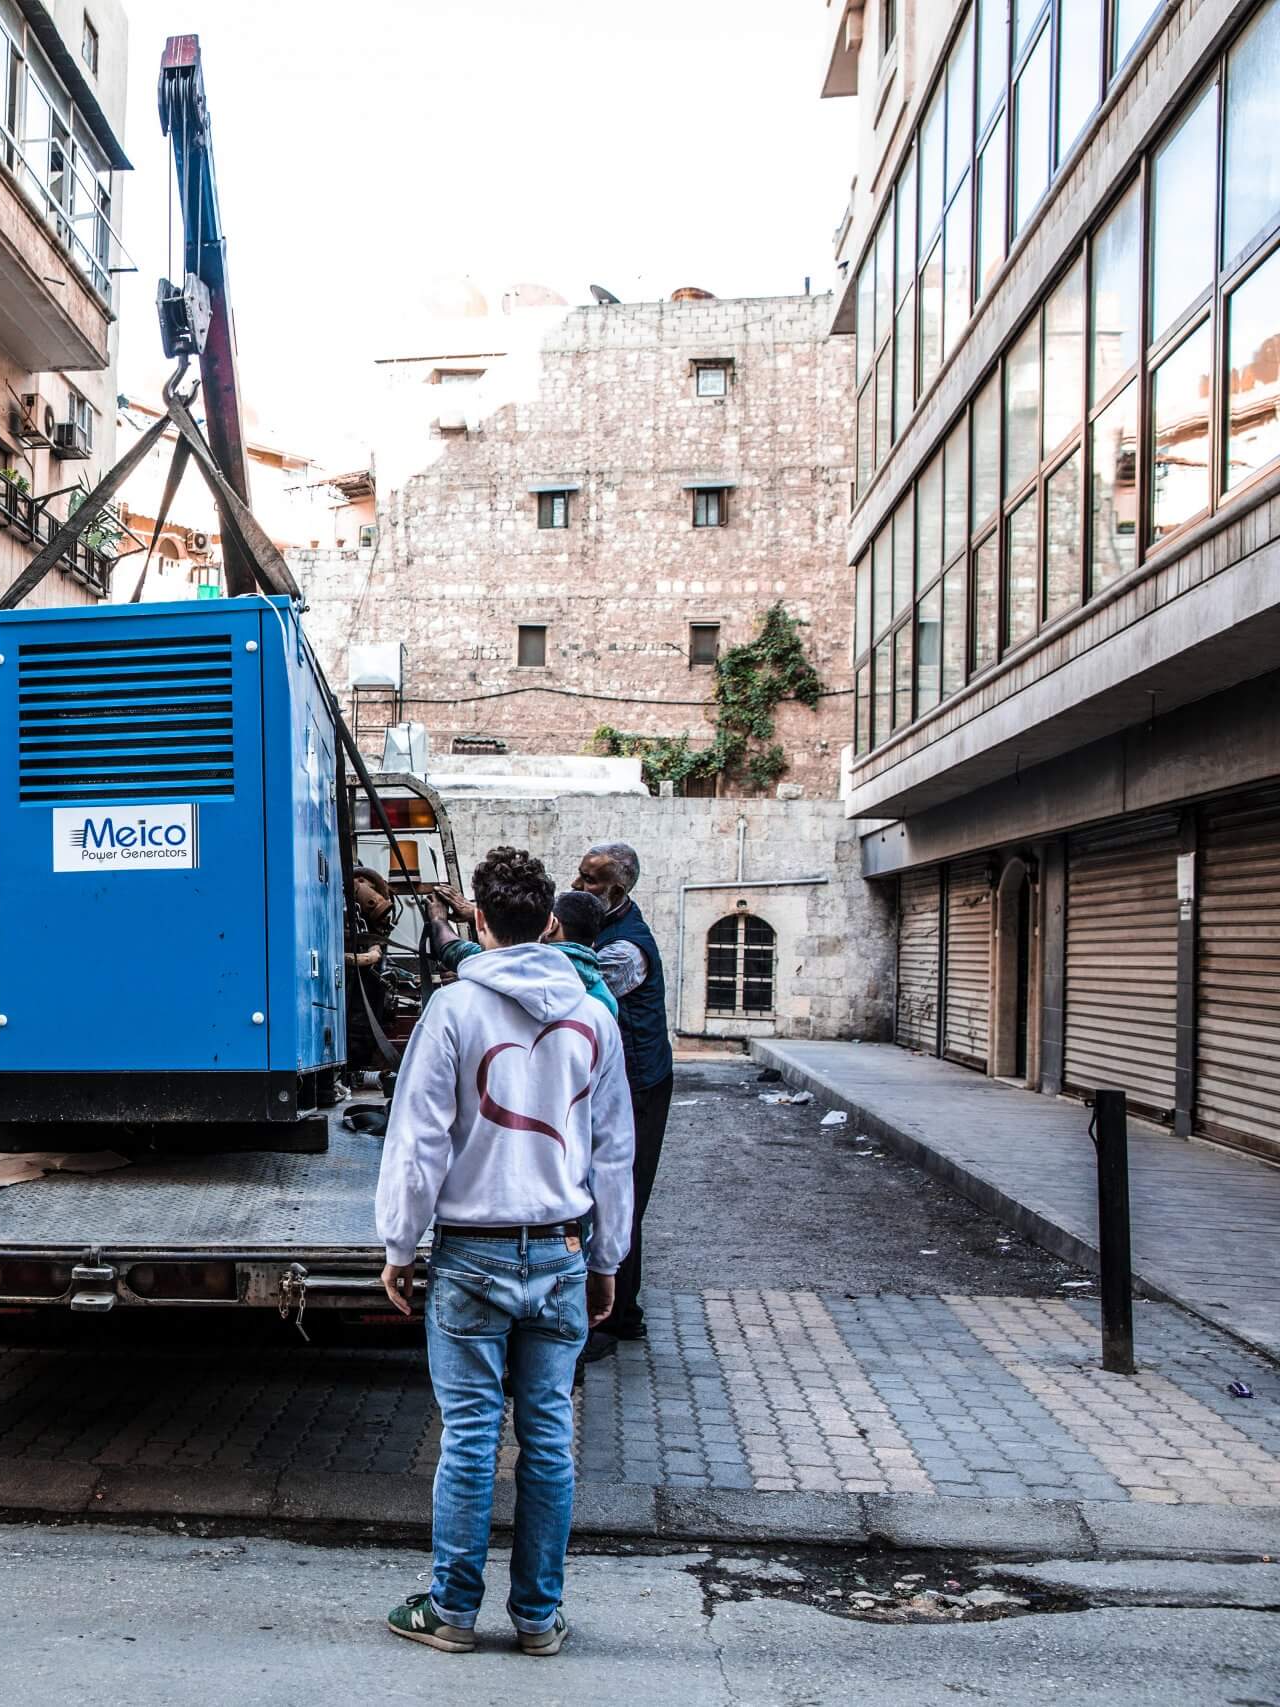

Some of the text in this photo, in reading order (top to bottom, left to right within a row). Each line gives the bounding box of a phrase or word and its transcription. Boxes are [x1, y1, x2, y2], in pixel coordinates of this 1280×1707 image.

[82, 817, 186, 849] Meico
[81, 848, 188, 860] Power Generators
[411, 1609, 425, 1629] N
